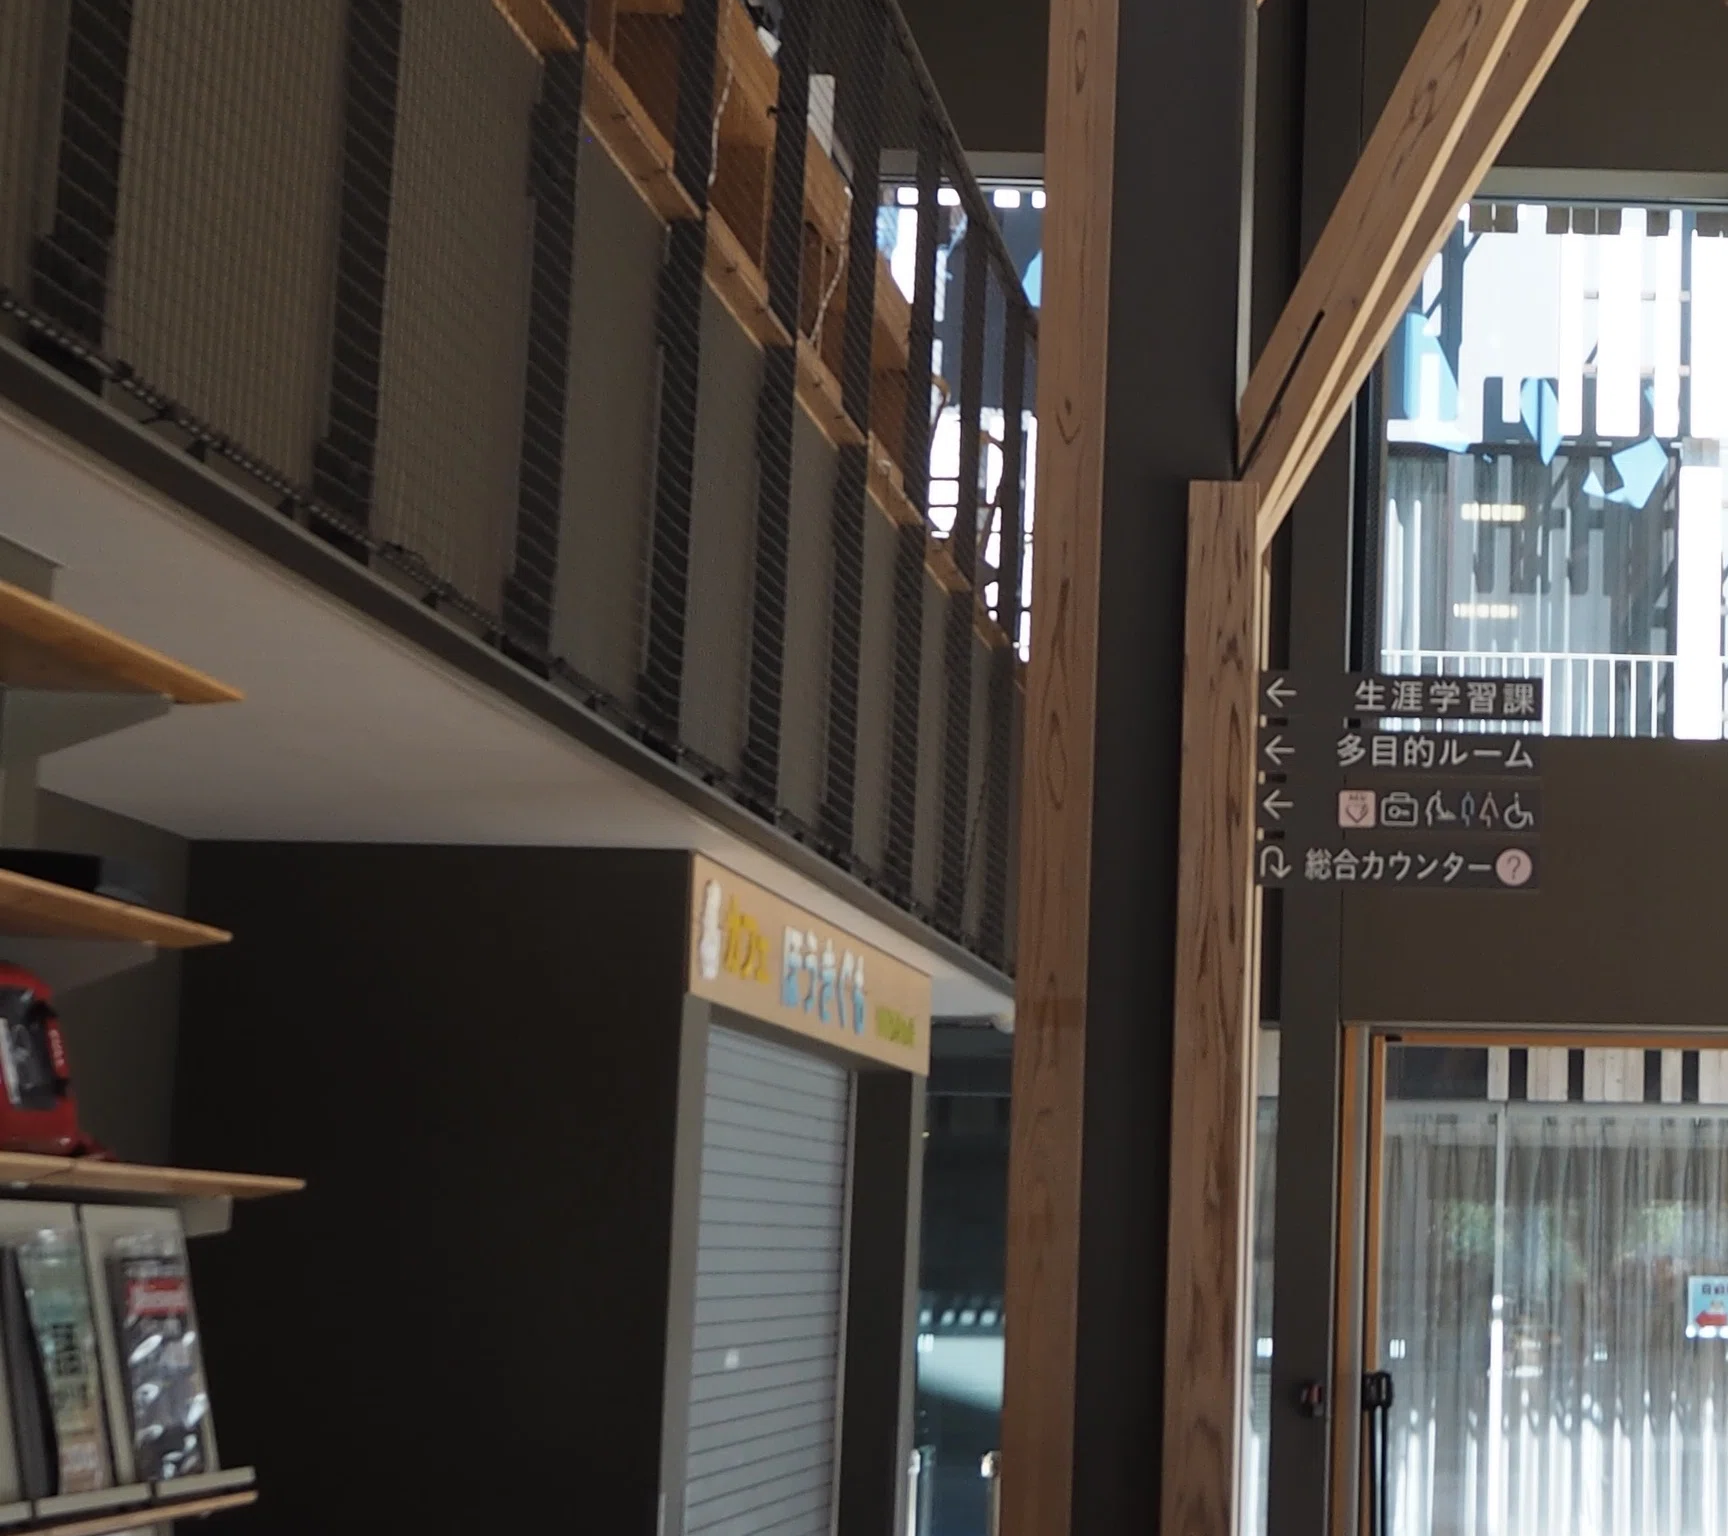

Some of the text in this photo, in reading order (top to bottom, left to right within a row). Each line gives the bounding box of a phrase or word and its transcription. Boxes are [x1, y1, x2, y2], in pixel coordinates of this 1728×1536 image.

[1354, 679, 1535, 714] 生涯学習課
[1336, 734, 1534, 768] 多目的ルーム
[1305, 848, 1492, 881] 総合カウンター
